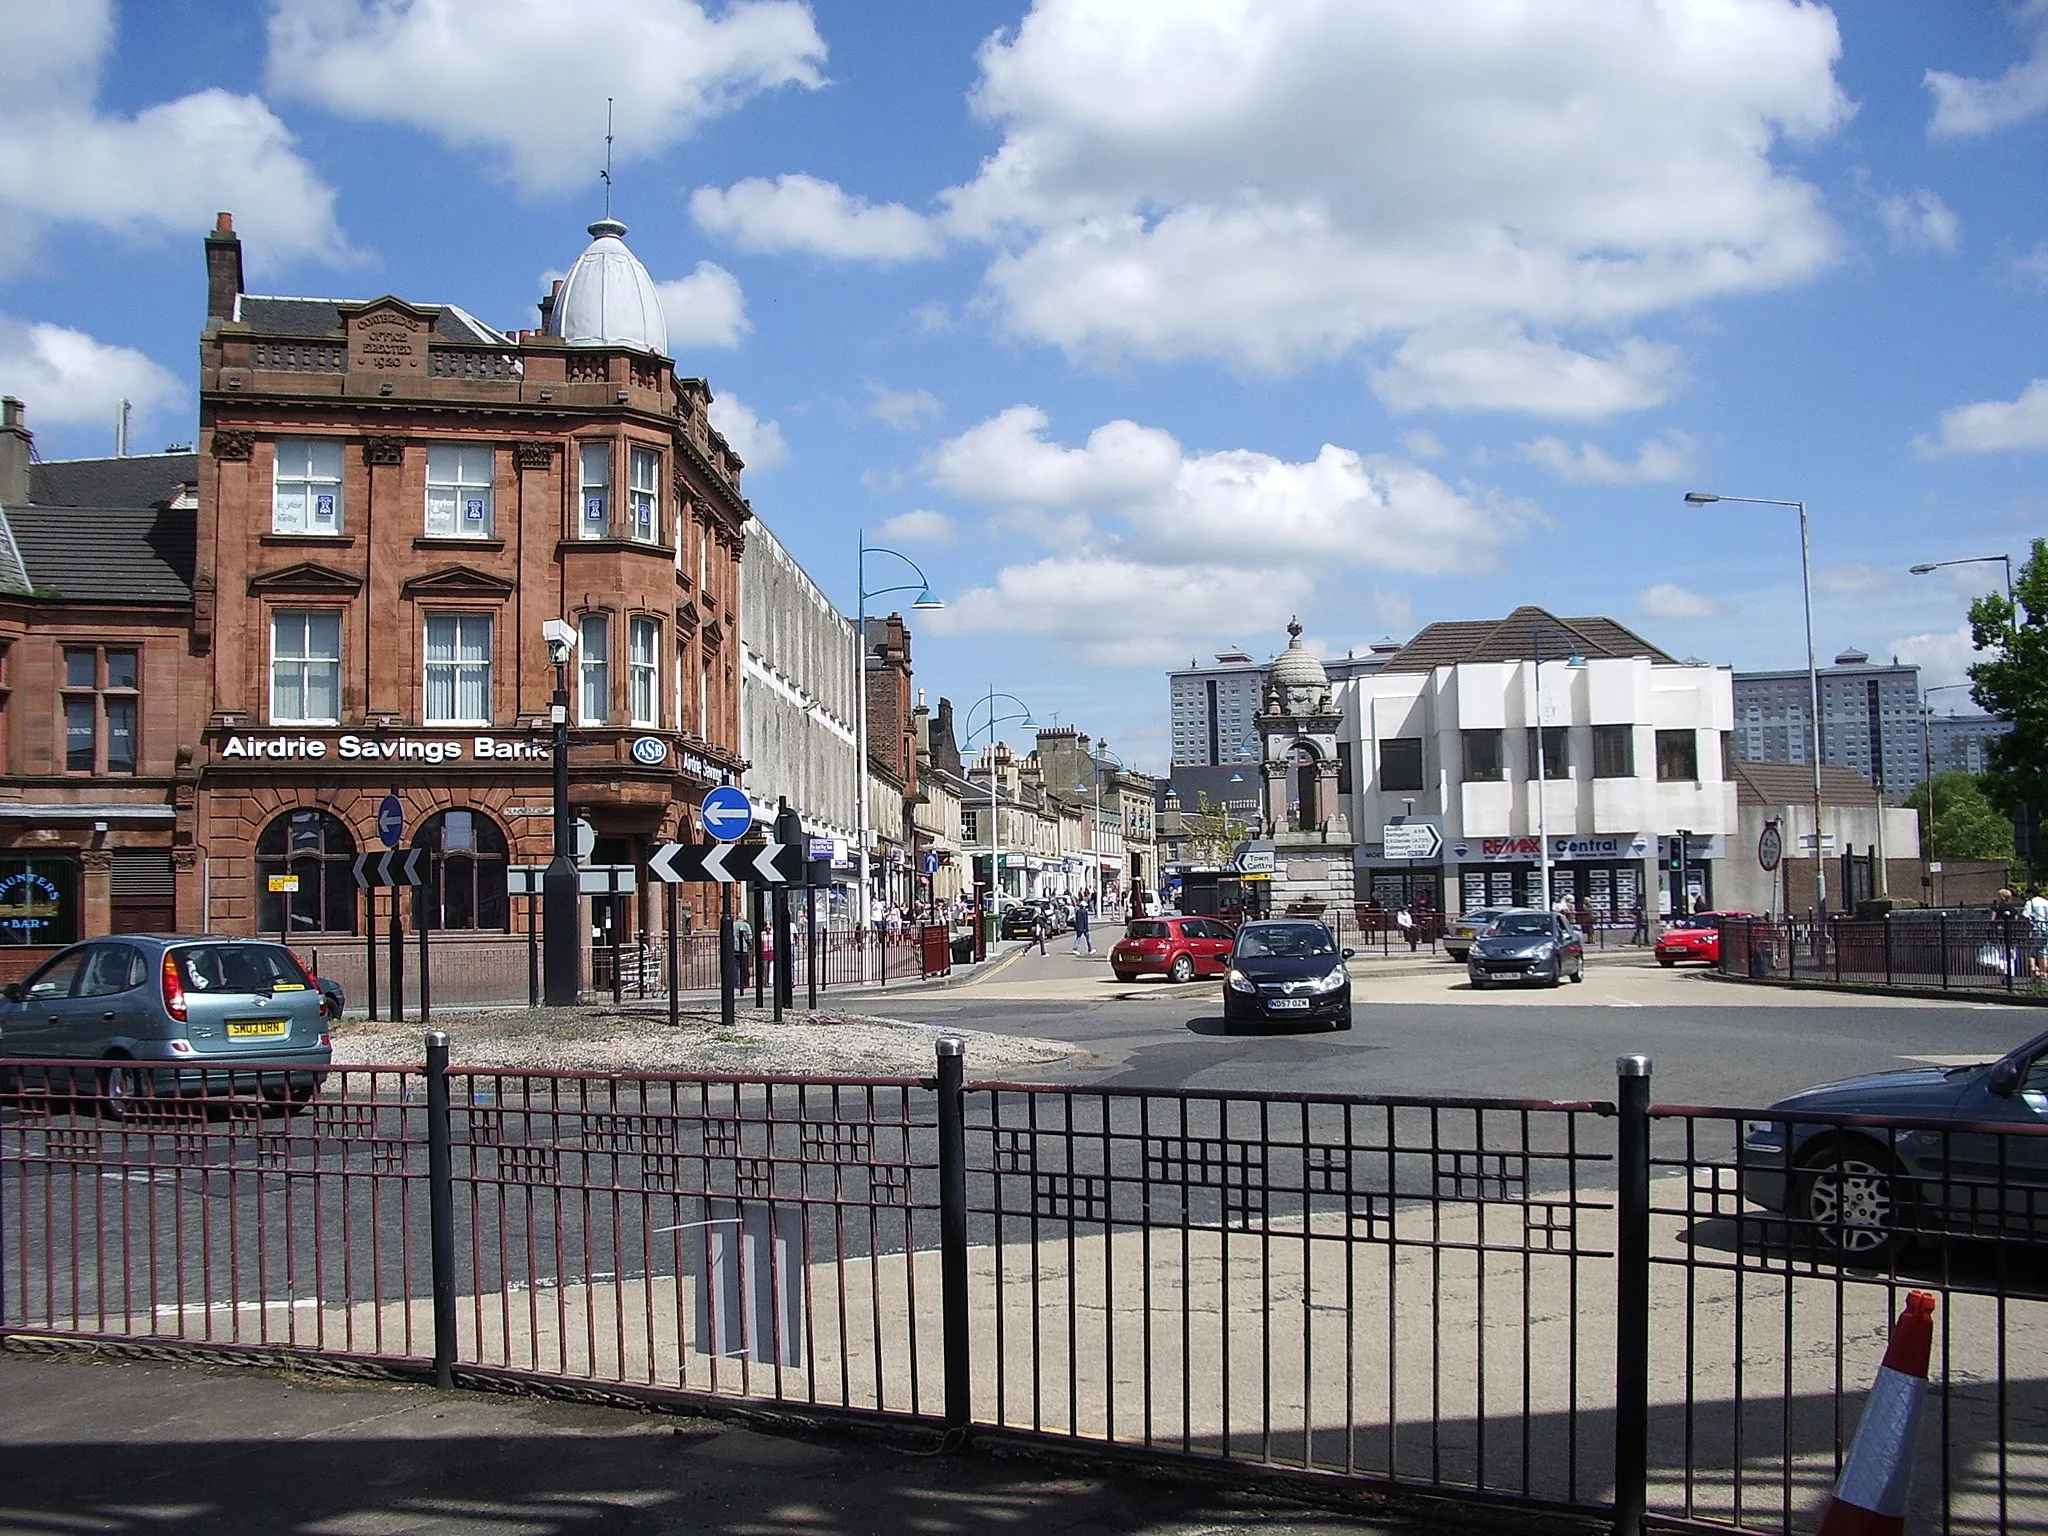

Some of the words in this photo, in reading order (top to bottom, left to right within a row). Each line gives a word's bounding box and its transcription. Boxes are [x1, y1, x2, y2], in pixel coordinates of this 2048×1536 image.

[369, 332, 408, 343] OFFICE
[363, 343, 412, 355] ERECTED
[374, 357, 401, 369] 1920
[222, 736, 326, 758] Airdrie
[338, 735, 462, 763] Savings
[474, 736, 550, 758] Bank
[638, 740, 663, 760] ASB
[683, 751, 702, 775] Airdrie
[702, 758, 723, 787] Savings
[1482, 839, 1541, 854] RE/MAX
[1555, 838, 1618, 852] Central
[1247, 862, 1272, 870] Centre
[12, 919, 40, 928] BAR
